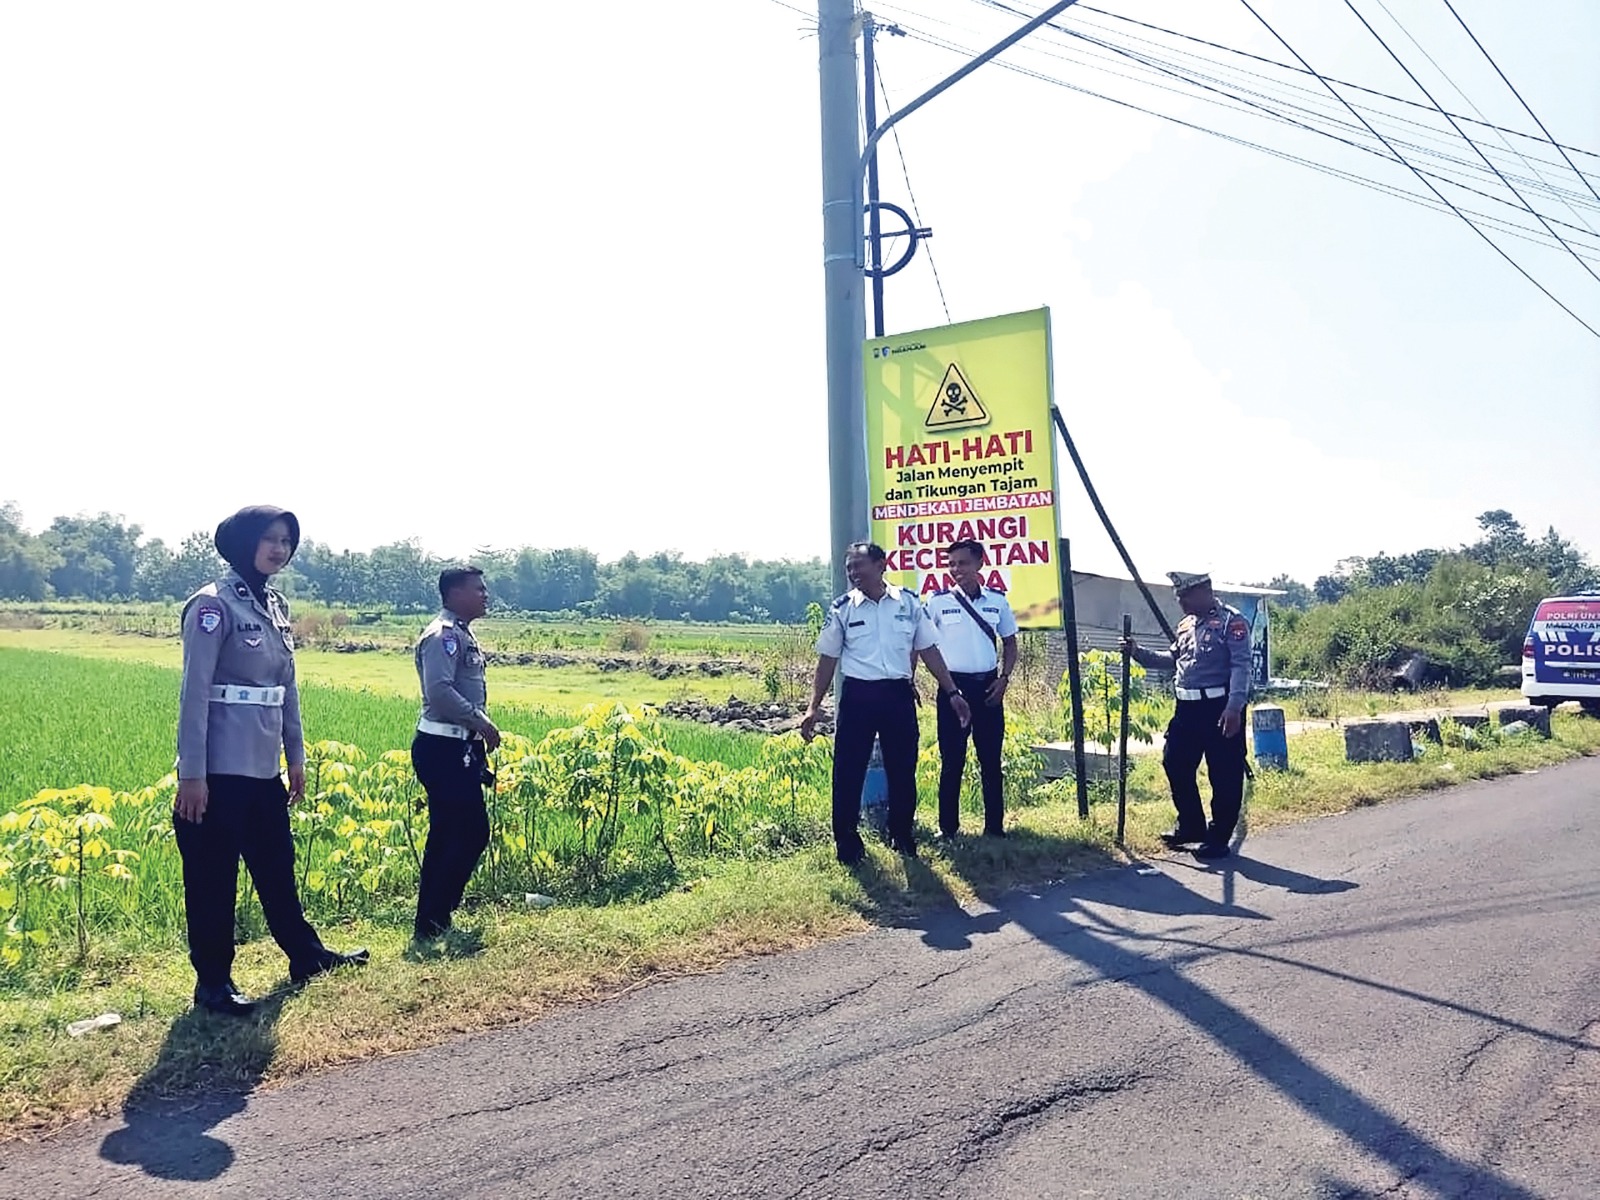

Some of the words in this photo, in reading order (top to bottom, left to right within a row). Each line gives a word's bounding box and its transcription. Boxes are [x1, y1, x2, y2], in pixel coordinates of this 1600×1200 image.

[885, 430, 1033, 469] HATI-HATI
[896, 469, 935, 483] Jalan
[938, 458, 1024, 479] Menyempit
[885, 488, 913, 501] dan
[916, 482, 986, 498] Tikungan
[990, 477, 1038, 493] Tajam
[875, 501, 962, 519] MENDEKATI
[965, 492, 1052, 512] JEMBATAN
[898, 516, 1026, 546] KURANGI
[885, 541, 1050, 571] KECETAN
